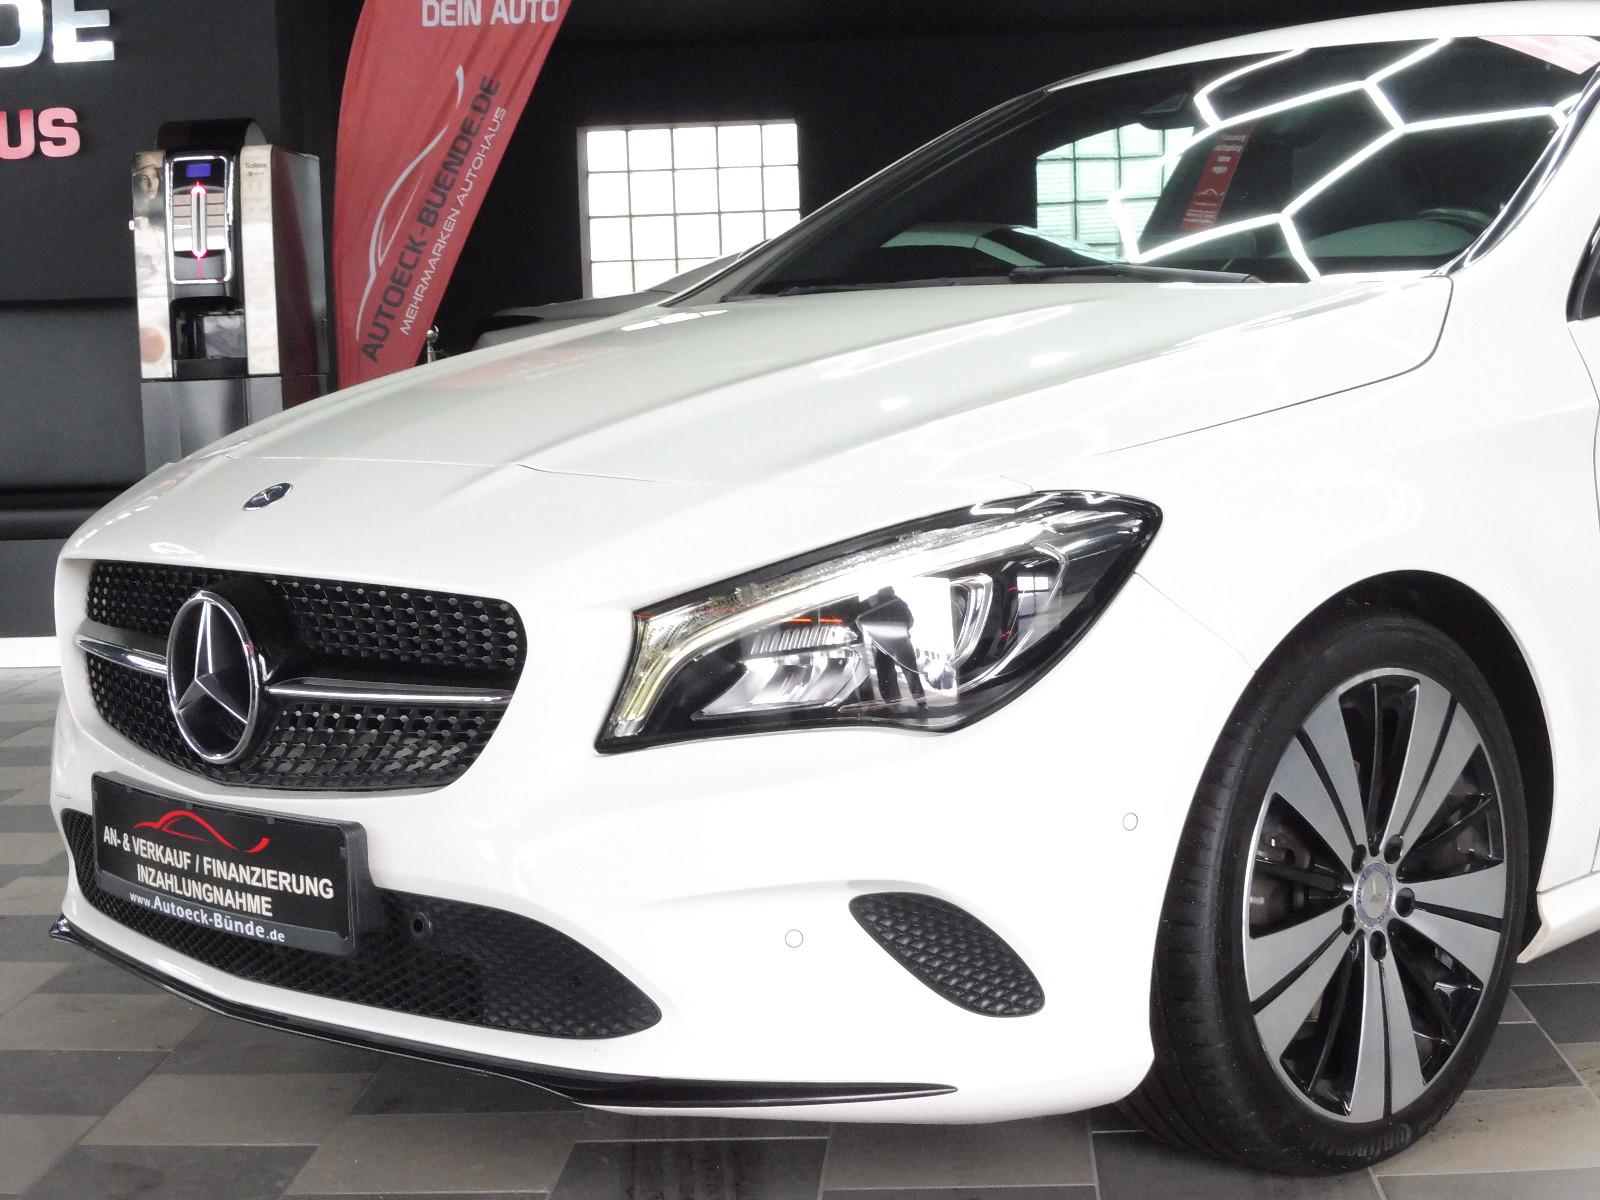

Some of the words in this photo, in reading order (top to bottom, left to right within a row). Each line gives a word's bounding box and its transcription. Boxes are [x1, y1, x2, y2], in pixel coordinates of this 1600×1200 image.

[422, 0, 482, 27] DEIN
[490, 0, 560, 25] AUTO
[0, 107, 81, 160] US
[361, 75, 501, 363] AUTOECK-BUENDE.DE
[400, 208, 461, 336] MEHRMARKEN
[456, 107, 506, 208] AUTOHAUS
[103, 825, 121, 847] AN-
[122, 832, 130, 852] &
[131, 835, 192, 871] VERKAUF
[203, 856, 334, 899] FINANZIERUNG
[137, 863, 273, 917] INZAHLUNGNAHME
